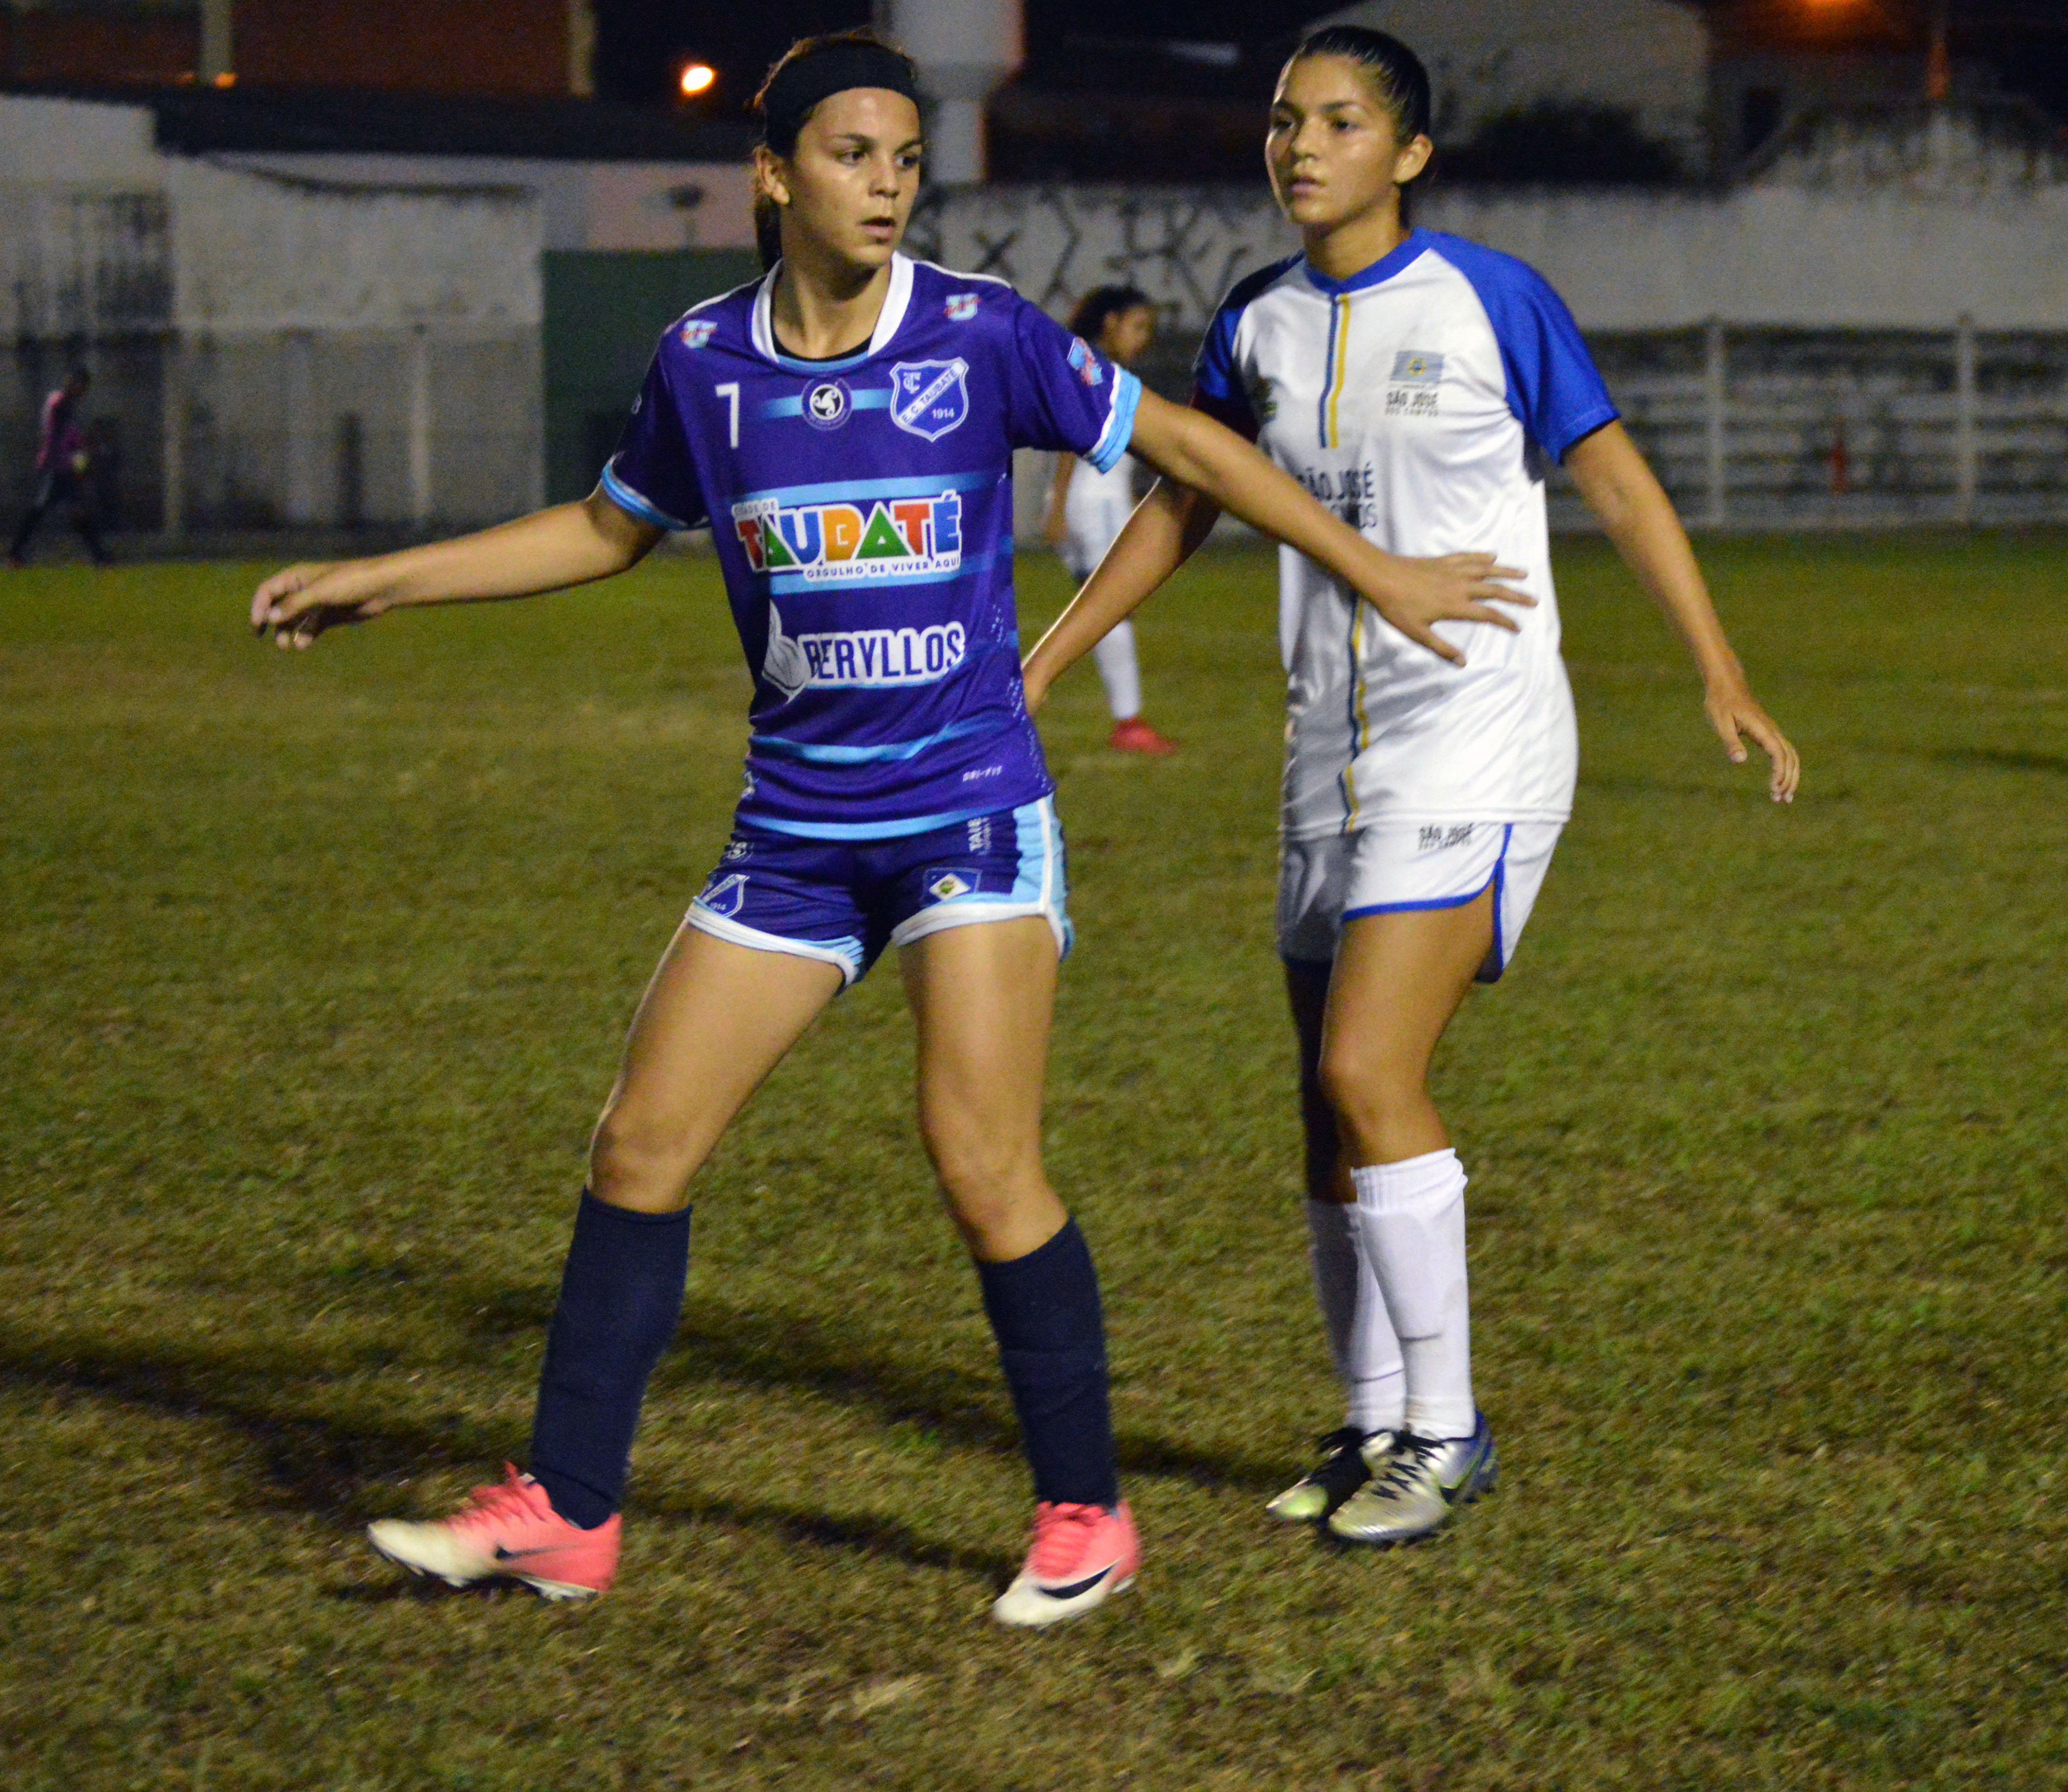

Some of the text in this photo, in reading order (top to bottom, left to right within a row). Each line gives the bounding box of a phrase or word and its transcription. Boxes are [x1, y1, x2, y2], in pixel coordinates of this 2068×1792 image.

[715, 381, 740, 449] 7
[932, 408, 954, 419] 1914
[737, 494, 960, 568] TAUBATÉ
[807, 556, 960, 578] ORGULHO DE VIVER AQUI
[802, 629, 960, 679] BERYLLOS
